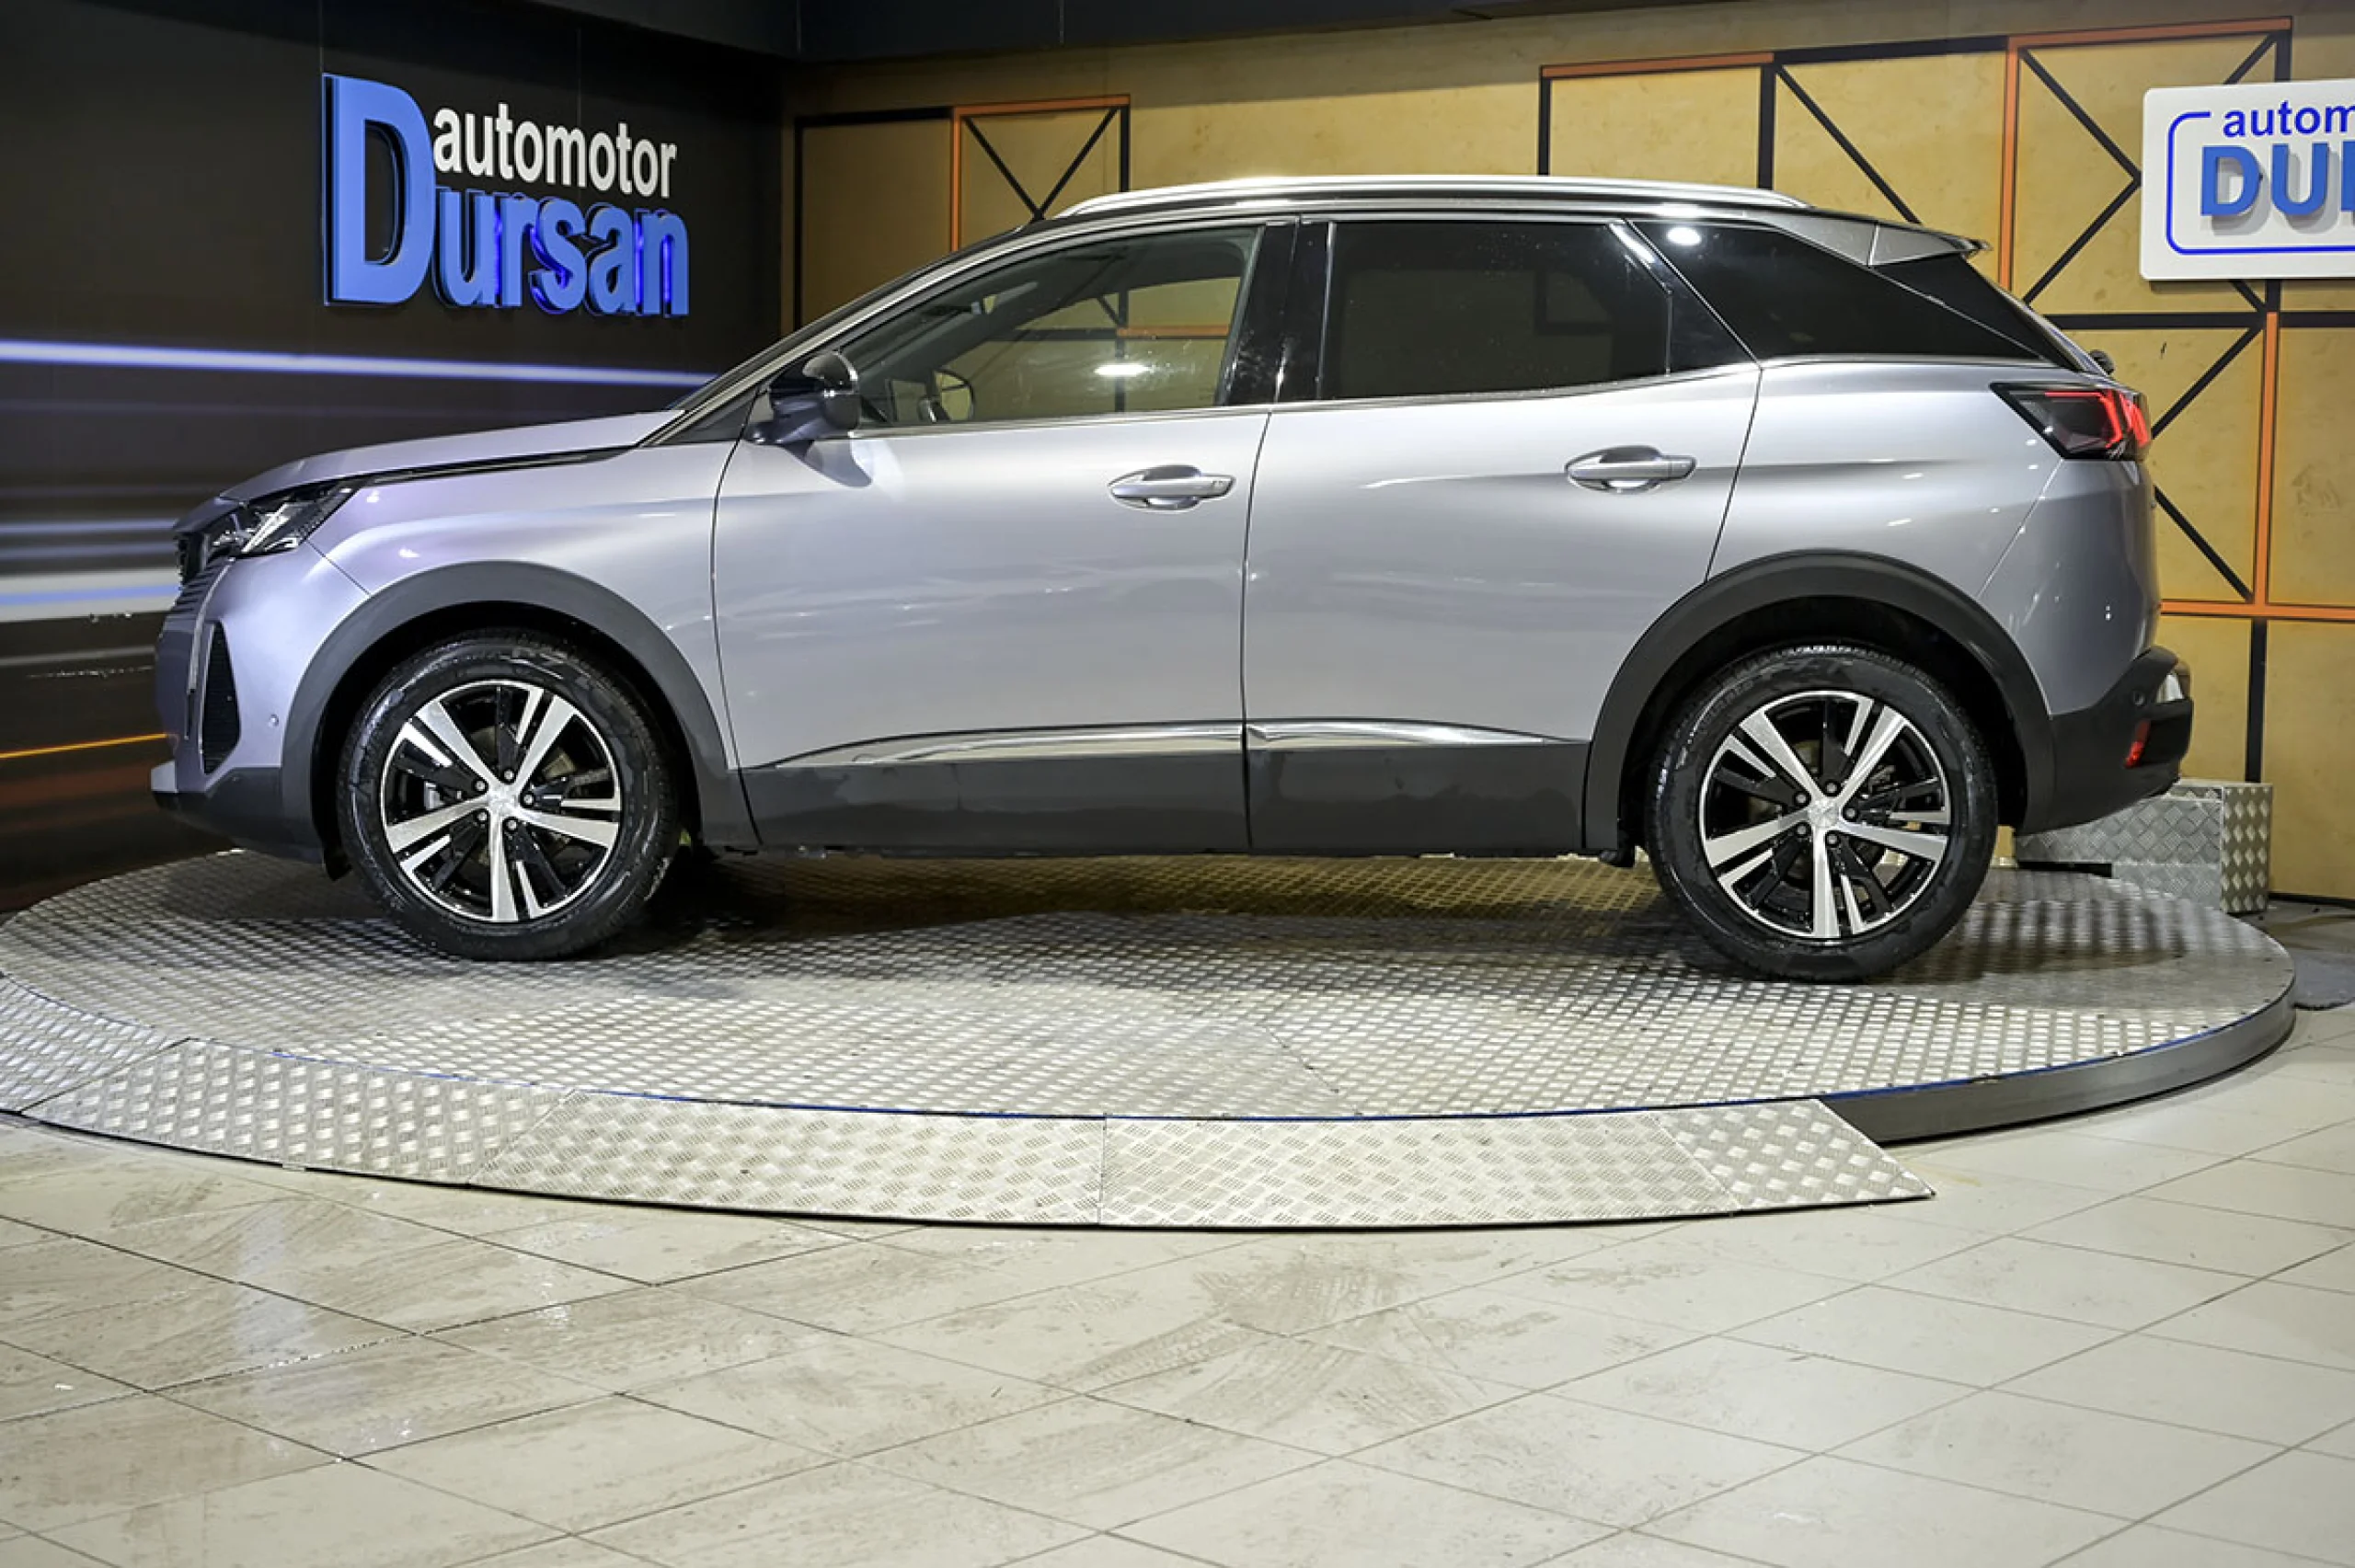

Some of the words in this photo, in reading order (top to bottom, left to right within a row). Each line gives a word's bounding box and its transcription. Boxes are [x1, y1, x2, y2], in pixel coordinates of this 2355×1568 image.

[322, 73, 690, 318] Dursan
[432, 102, 678, 199] automotor
[2200, 141, 2355, 217] DU
